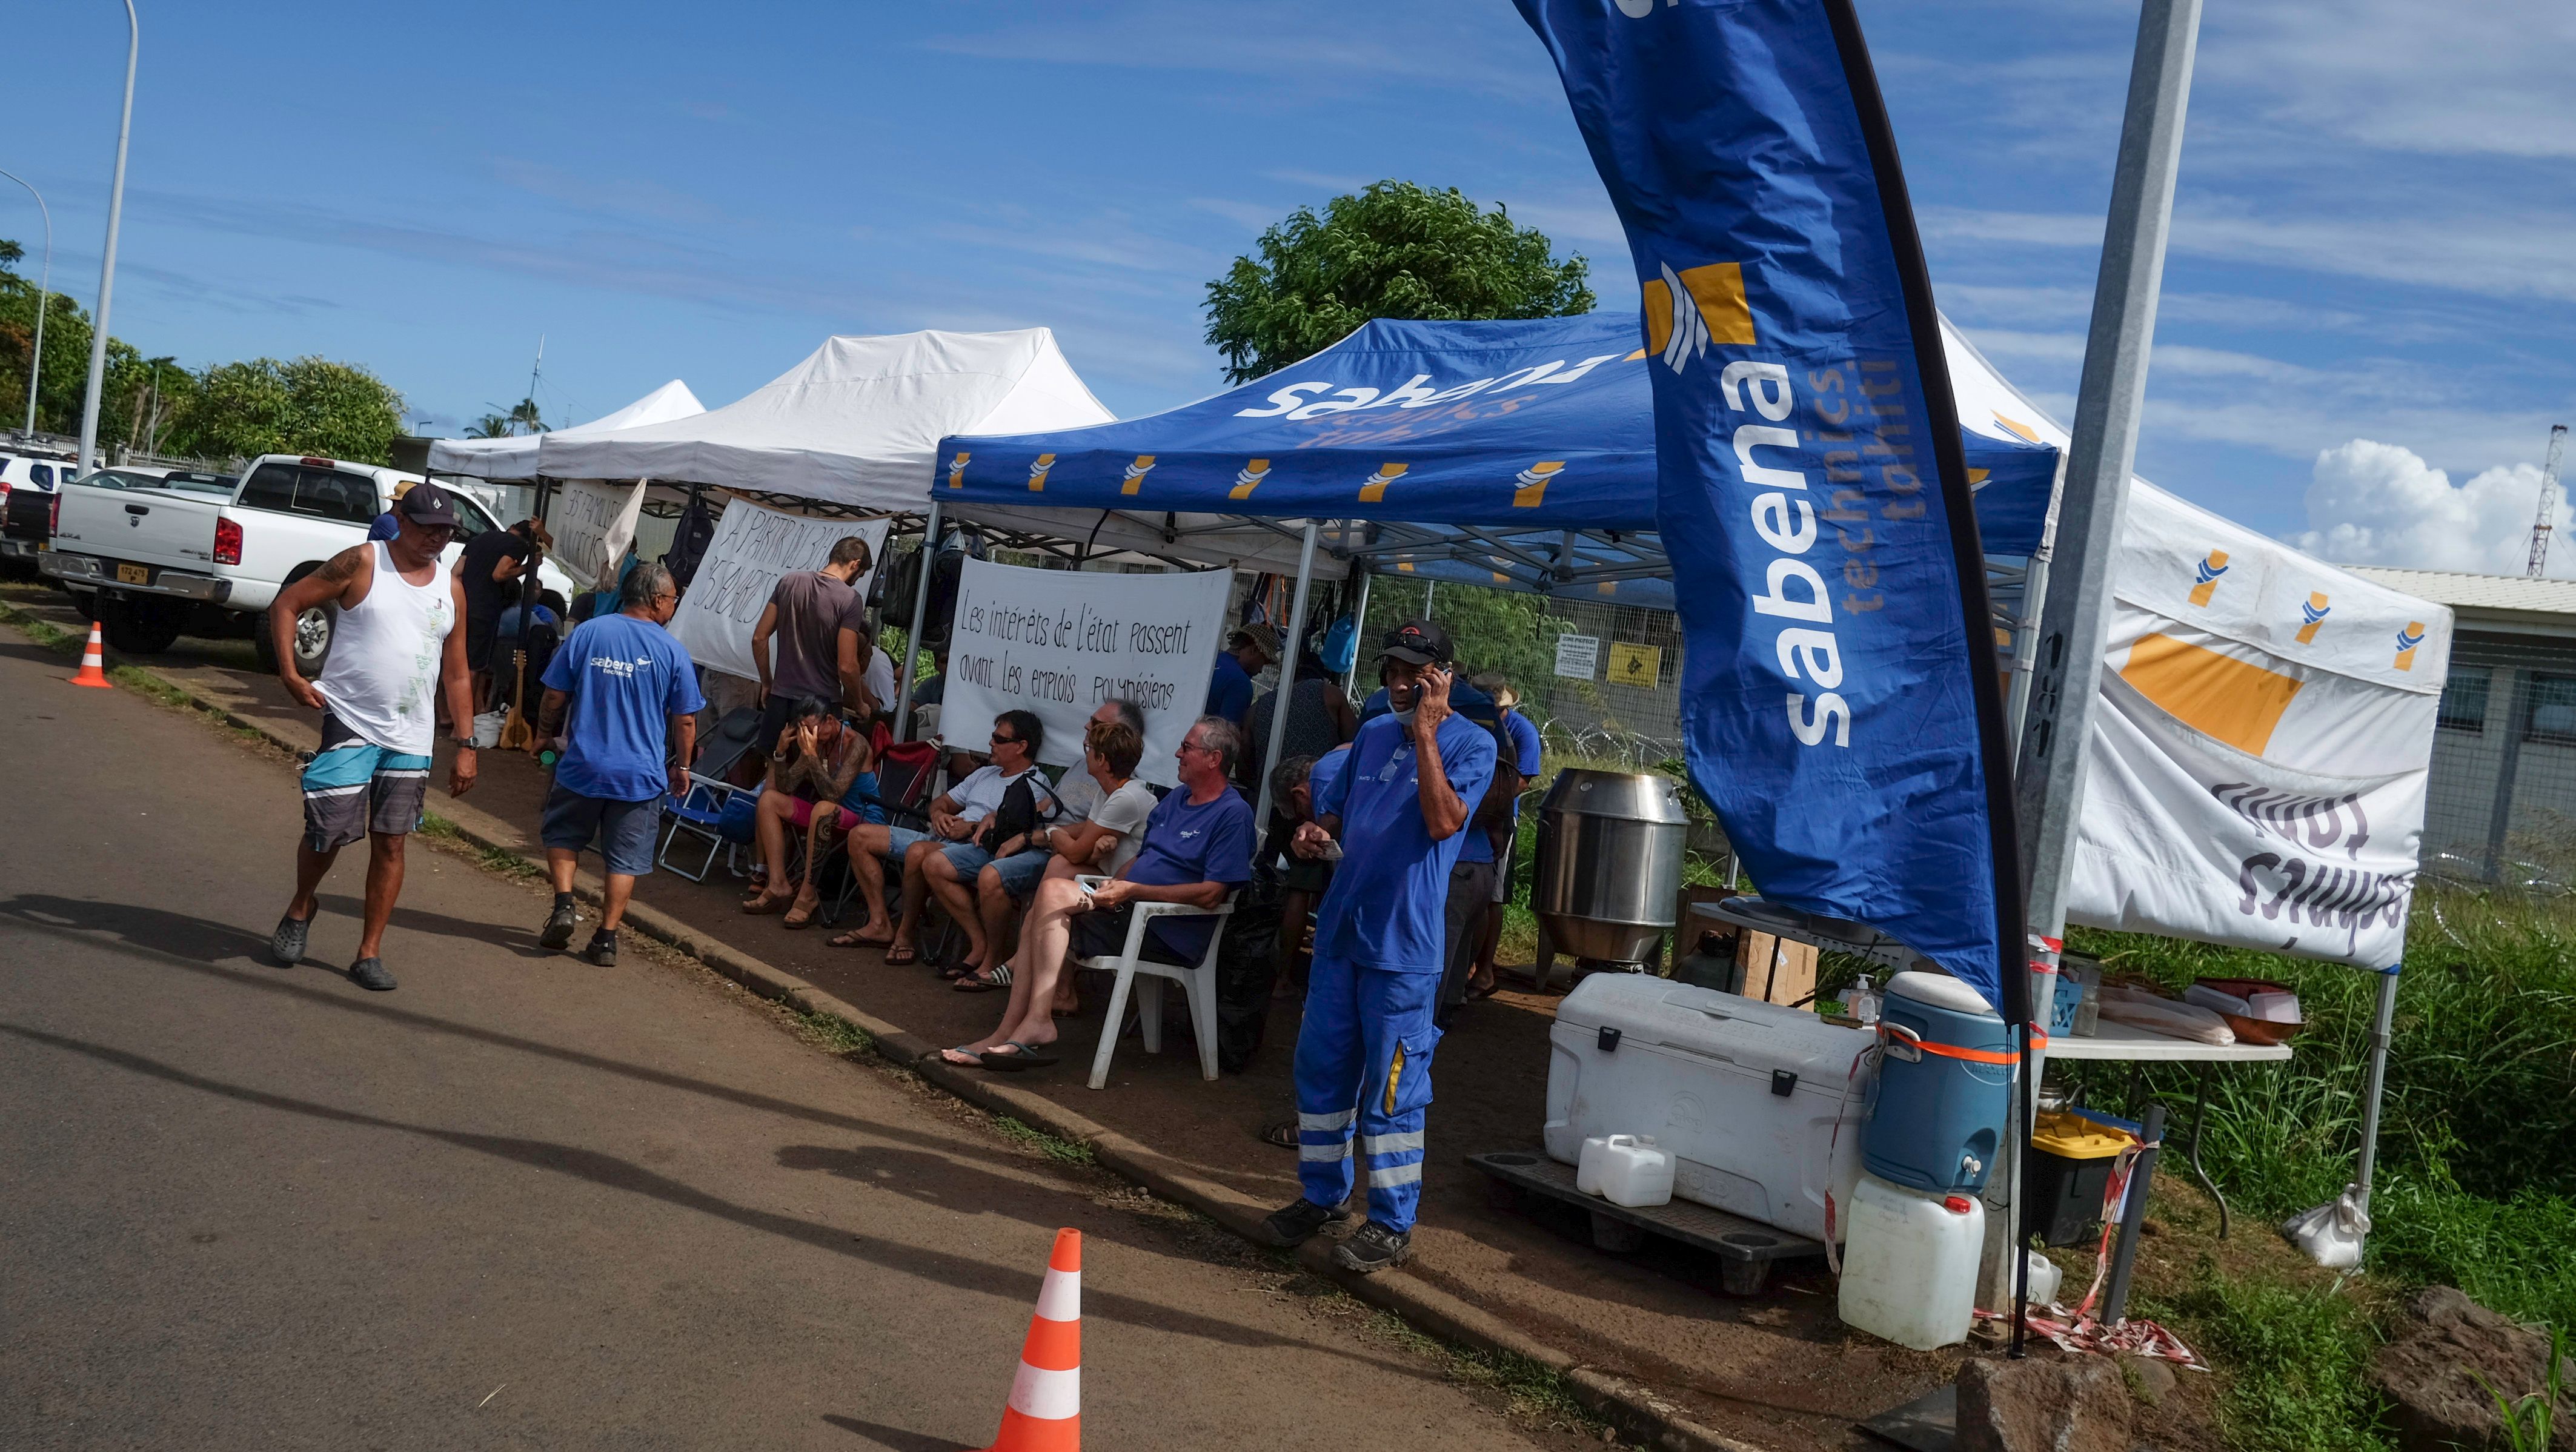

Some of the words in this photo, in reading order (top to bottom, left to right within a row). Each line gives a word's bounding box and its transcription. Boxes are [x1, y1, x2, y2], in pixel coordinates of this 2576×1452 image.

[1855, 360, 1927, 522] tahiti
[565, 489, 583, 517] 95
[1803, 370, 1884, 615] technics
[1721, 360, 1850, 748] sabena
[961, 589, 984, 633] Les
[989, 600, 1049, 646] intérêts
[1054, 608, 1072, 648] de
[1077, 603, 1120, 653] l'état
[590, 656, 634, 672] sabena
[603, 668, 632, 678] technics
[960, 654, 994, 688] avant
[2239, 853, 2408, 957] echnics
